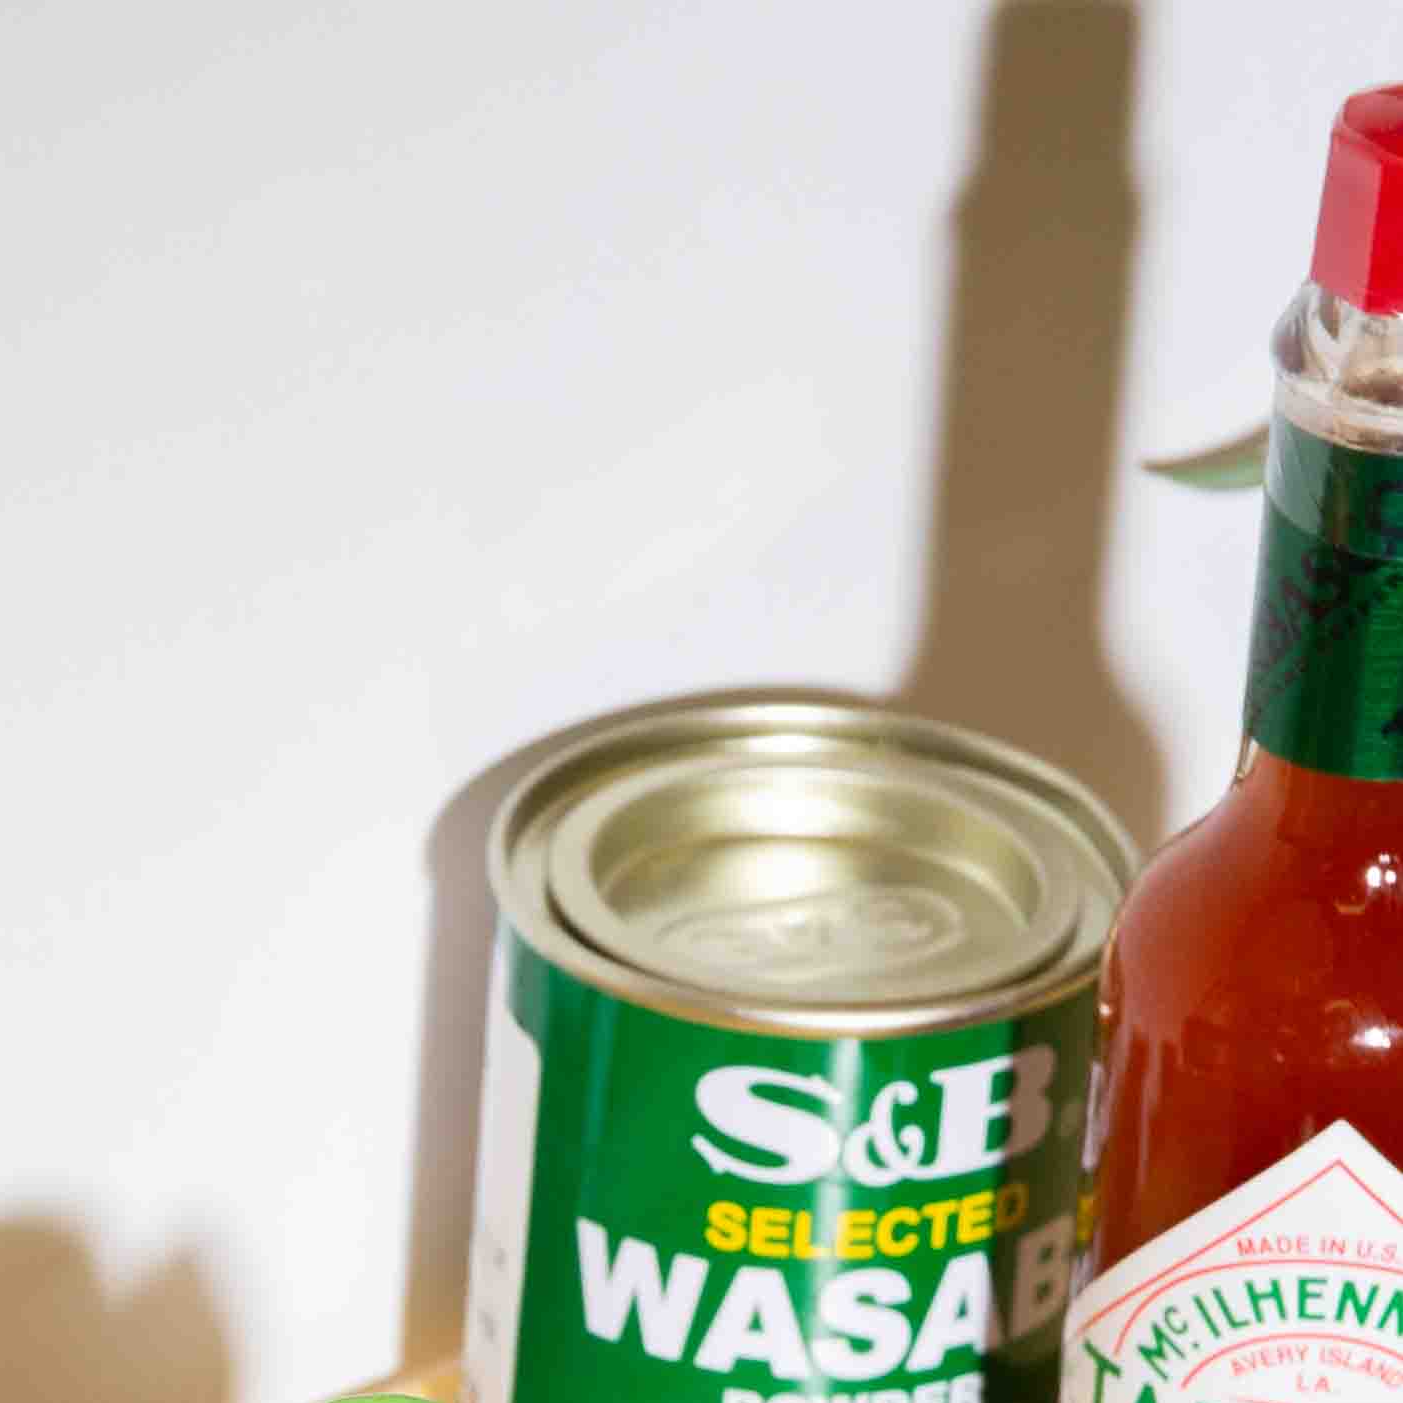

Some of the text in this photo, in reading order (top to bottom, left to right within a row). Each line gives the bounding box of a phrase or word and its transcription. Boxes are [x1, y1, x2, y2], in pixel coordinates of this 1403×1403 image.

[691, 1046, 1056, 1188] S&B
[706, 1183, 1028, 1260] SELECTED
[1236, 1234, 1309, 1256] MADE
[1317, 1234, 1348, 1256] IN
[576, 1214, 1075, 1381] WASAB
